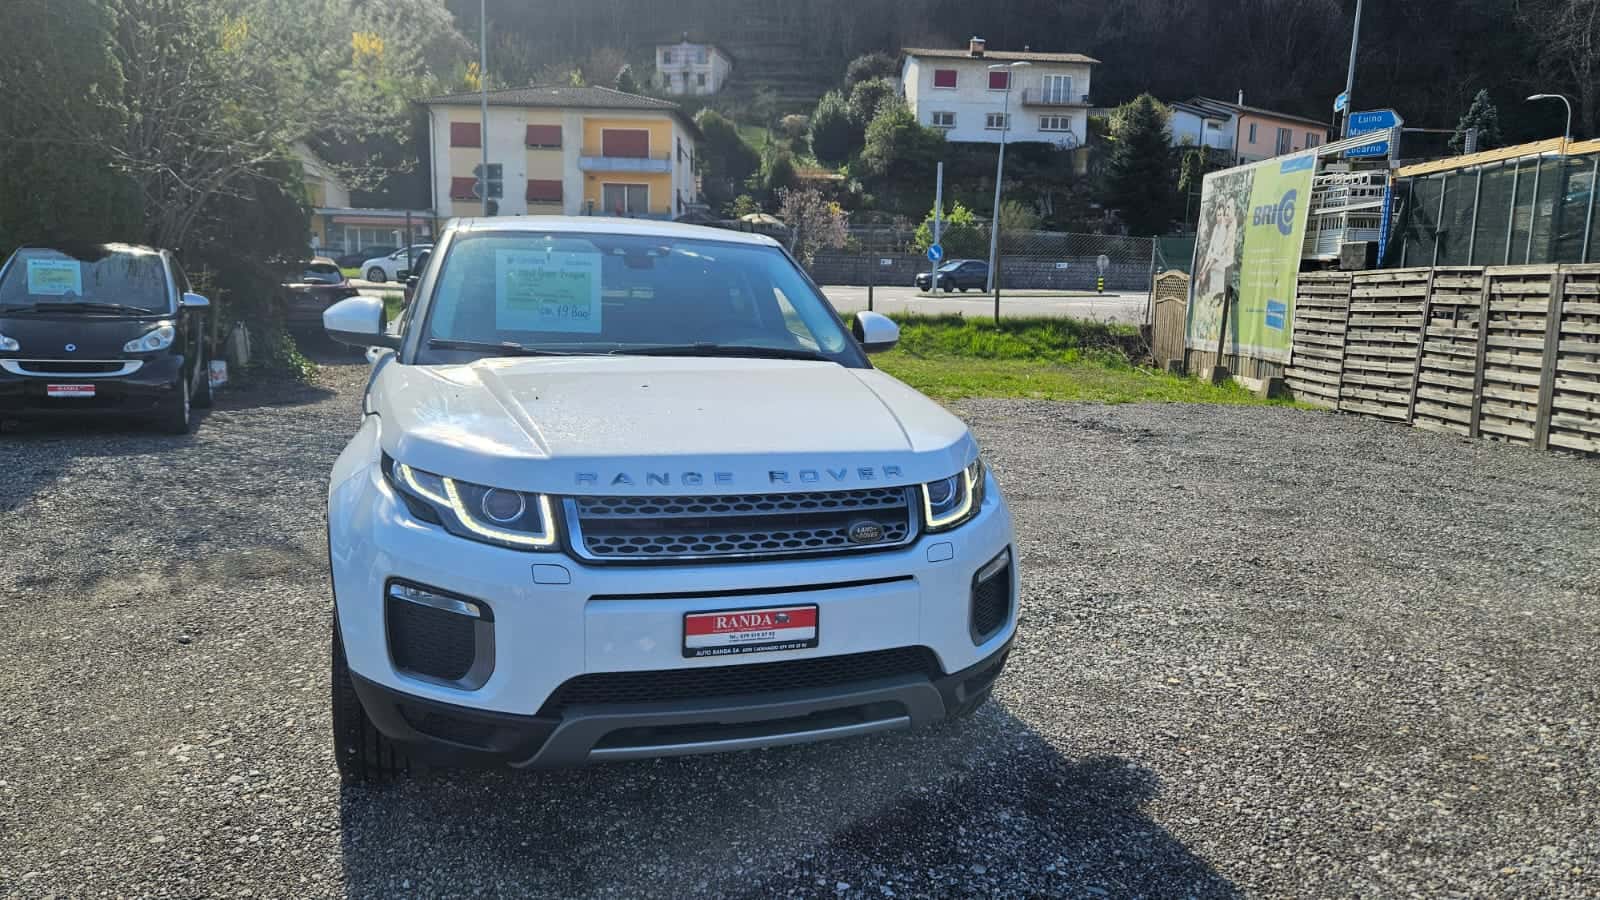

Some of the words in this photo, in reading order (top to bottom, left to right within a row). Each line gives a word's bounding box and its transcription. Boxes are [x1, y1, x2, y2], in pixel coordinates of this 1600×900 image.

[1358, 115, 1382, 124] Luino
[575, 471, 735, 487] RANGE
[768, 464, 904, 484] ROVER
[716, 613, 772, 629] RANDA
[712, 647, 731, 655] RANDA
